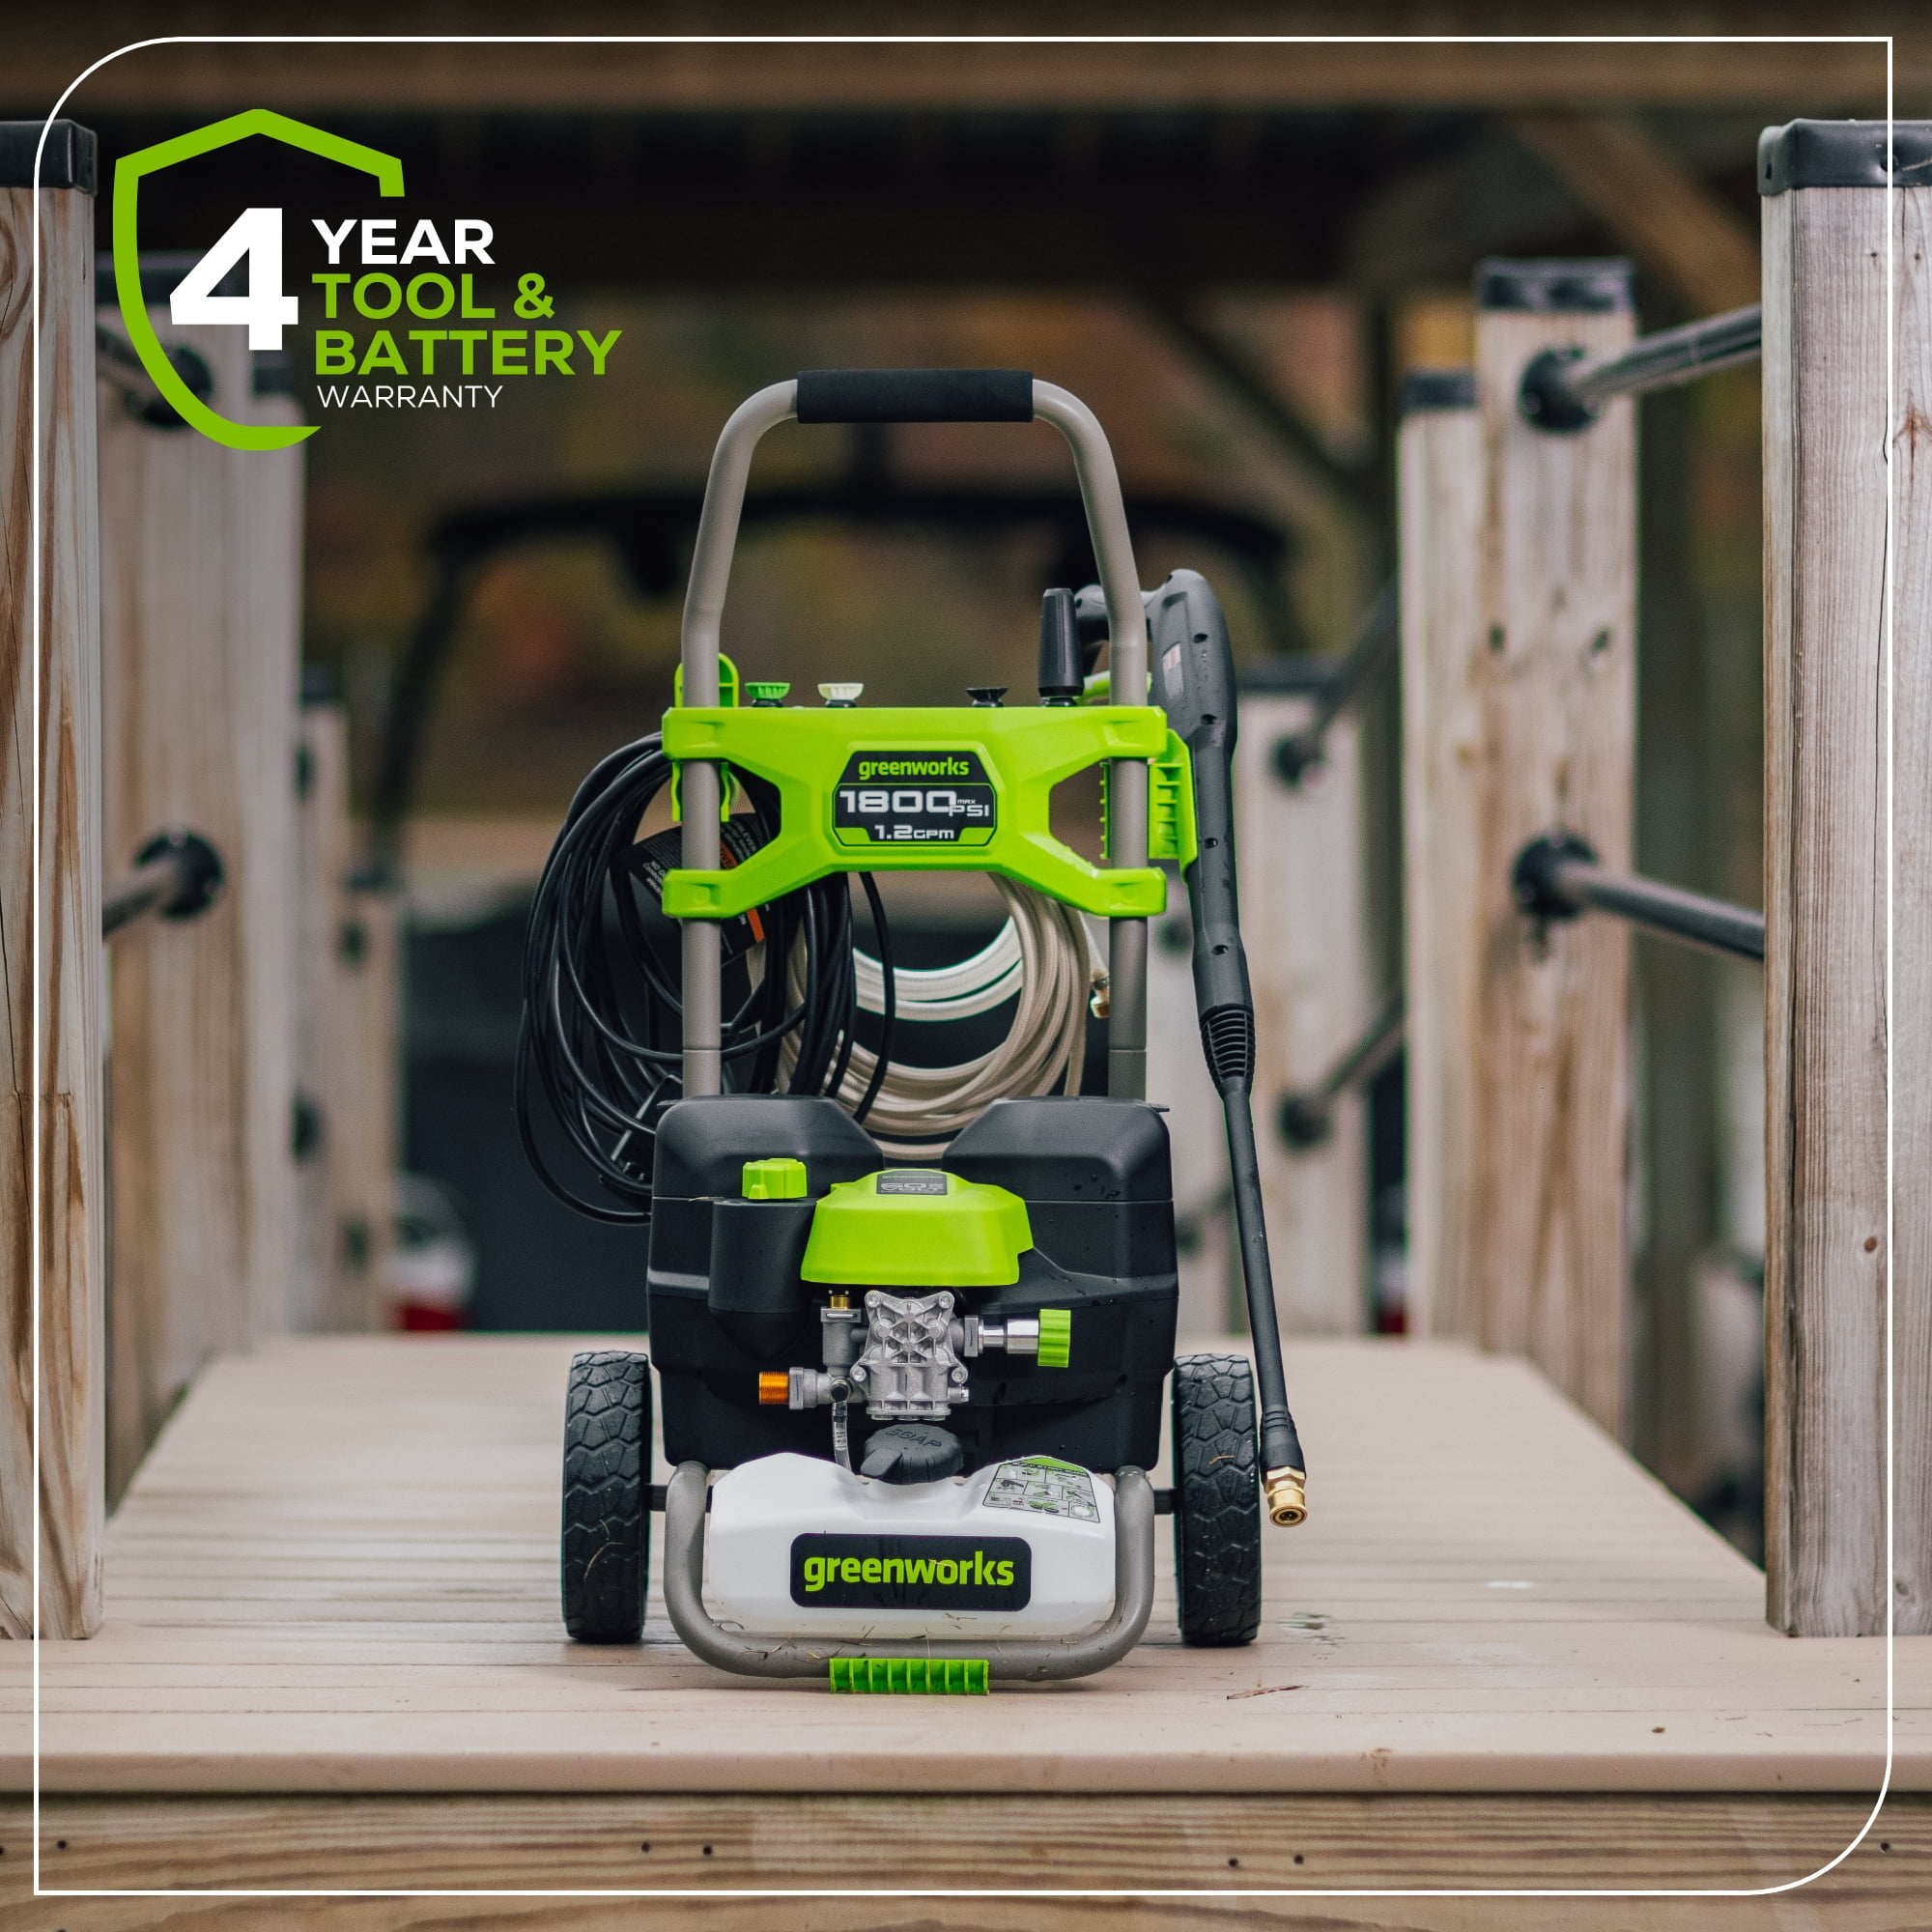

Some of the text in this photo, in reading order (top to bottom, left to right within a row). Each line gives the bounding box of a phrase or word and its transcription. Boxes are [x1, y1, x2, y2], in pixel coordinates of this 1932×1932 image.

[858, 756, 970, 781] greenworks
[838, 790, 990, 817] 1800 PSI
[885, 1428, 943, 1447] SOAP
[804, 1550, 1014, 1592] greenworks
